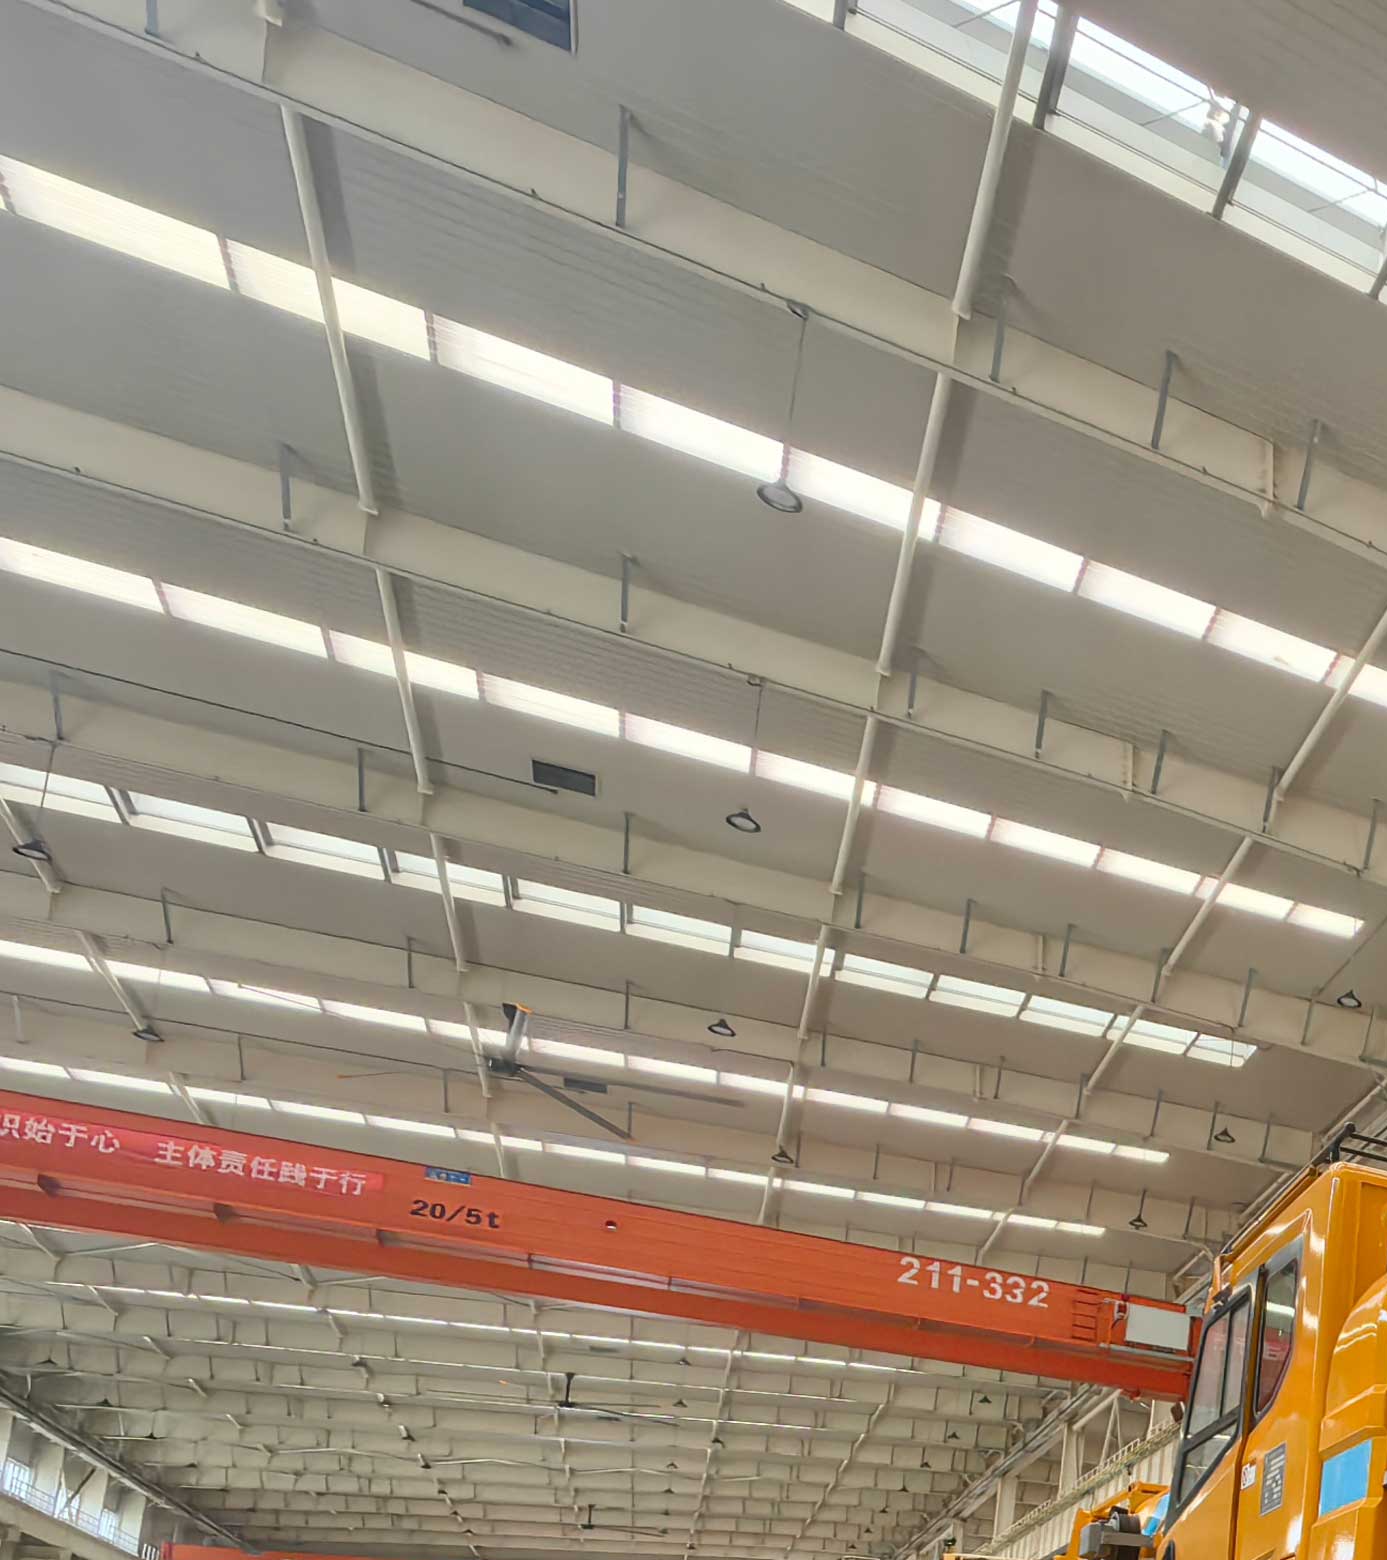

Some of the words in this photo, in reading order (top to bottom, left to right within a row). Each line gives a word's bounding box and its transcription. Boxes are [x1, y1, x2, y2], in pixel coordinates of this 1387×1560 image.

[153, 1140, 367, 1196] 主体责任践于行
[409, 1199, 501, 1229] 20/5t
[896, 1255, 1050, 1309] 211-332
